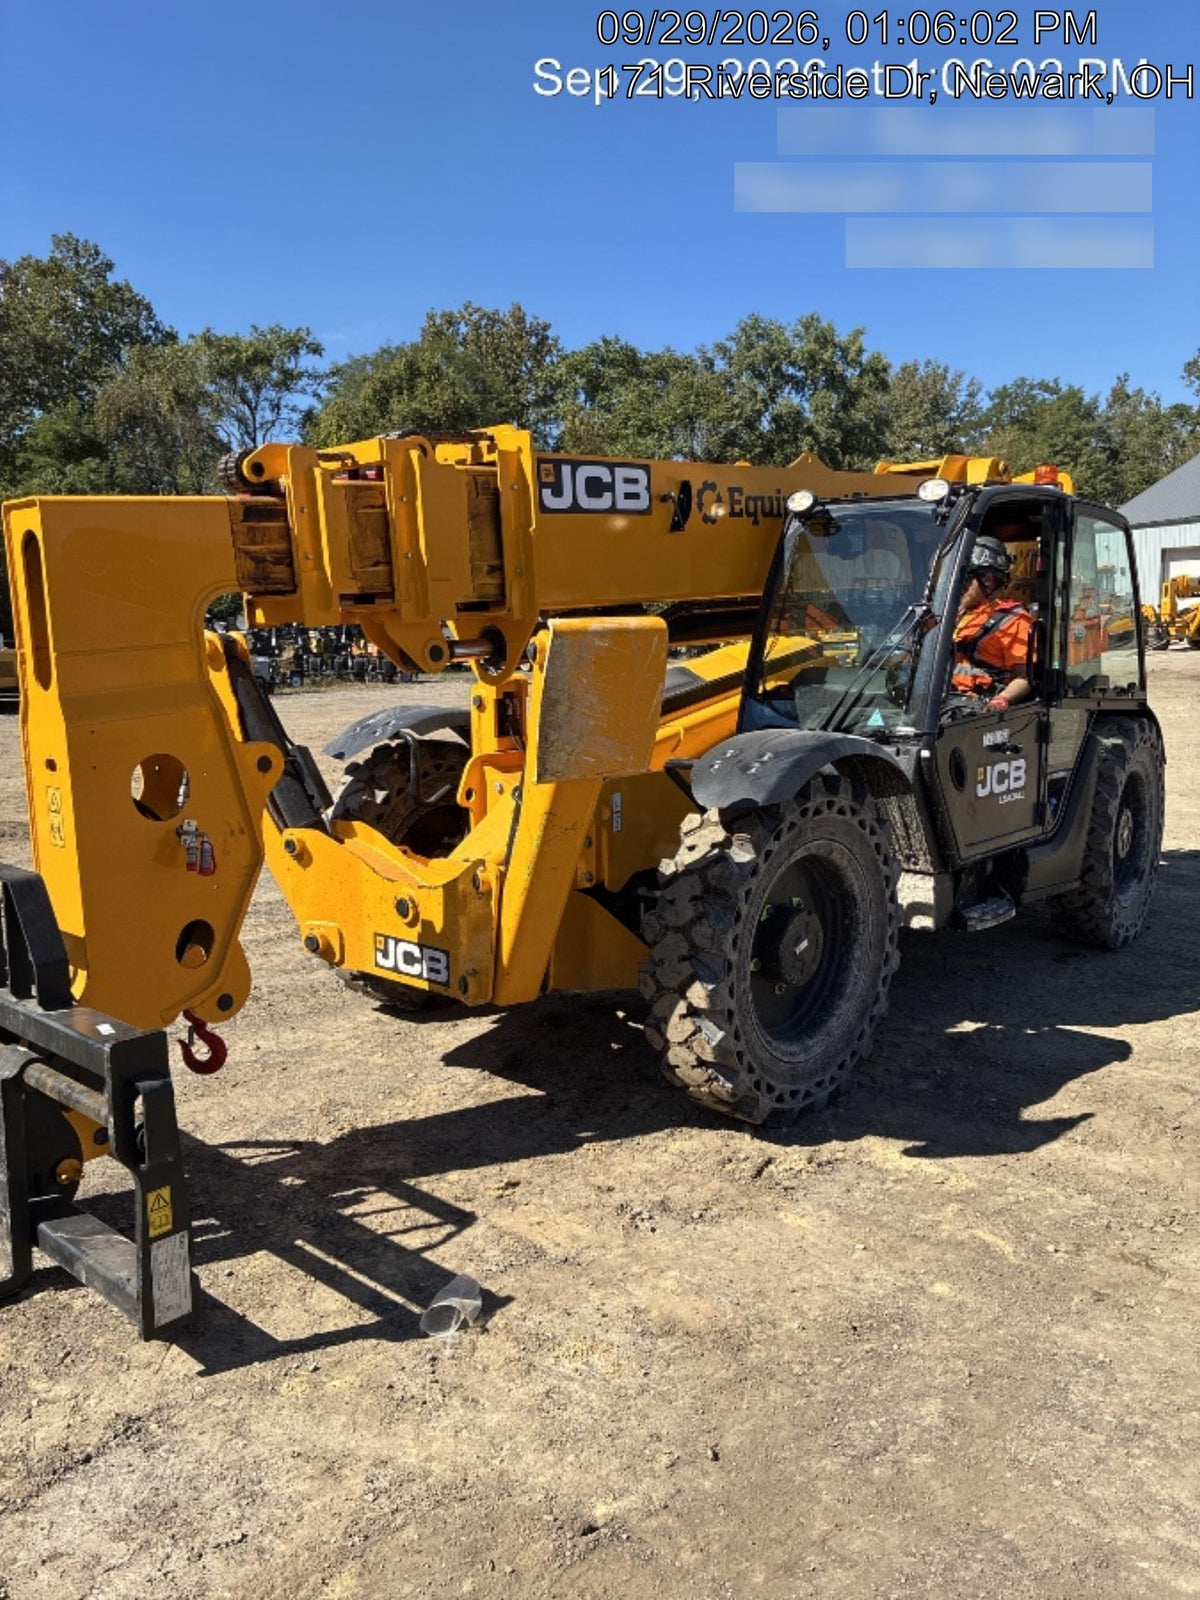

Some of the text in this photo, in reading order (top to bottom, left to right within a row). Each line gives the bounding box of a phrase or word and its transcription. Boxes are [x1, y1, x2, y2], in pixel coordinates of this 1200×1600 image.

[541, 464, 650, 511] JCB
[976, 758, 1027, 797] JCB
[376, 938, 449, 983] JCB
